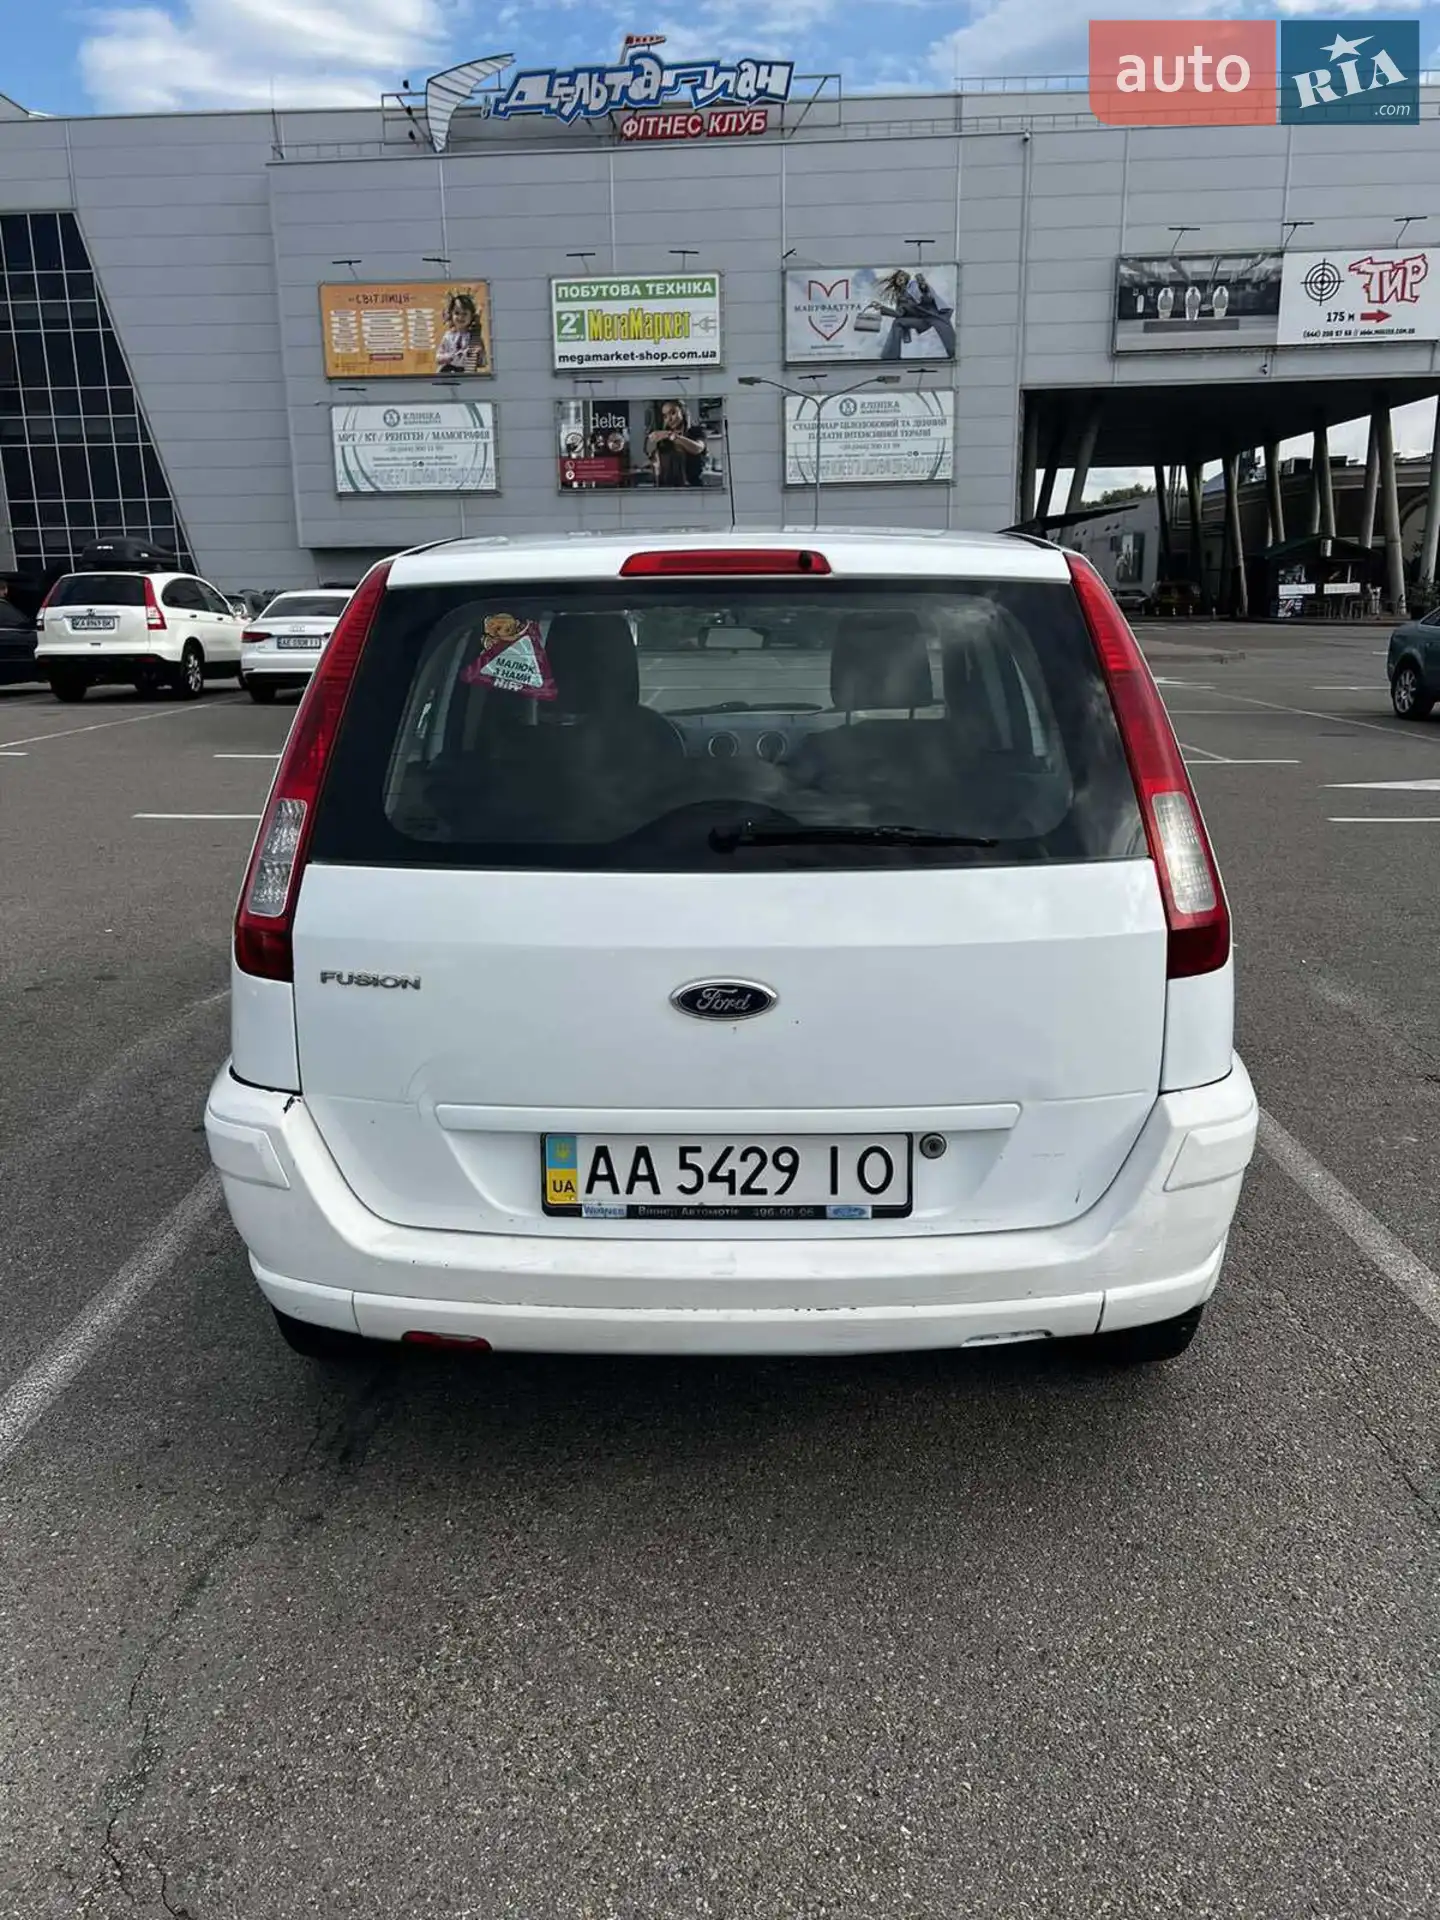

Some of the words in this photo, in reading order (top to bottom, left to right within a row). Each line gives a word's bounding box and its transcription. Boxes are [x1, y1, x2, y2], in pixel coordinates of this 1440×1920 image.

[622, 114, 702, 138] ФІТНЕС
[708, 110, 768, 133] КЛУБ
[1348, 253, 1429, 304] ТИР
[558, 283, 641, 299] ПОБУТОВА
[646, 281, 714, 298] ТЕХНІКА
[1326, 311, 1345, 322] 175
[588, 308, 691, 344] МегаМаркет
[558, 349, 717, 365] megamarket-shop.com.ua
[591, 412, 627, 429] delta
[496, 658, 535, 674] МАЛЮК
[501, 670, 531, 683] НАМИ
[320, 971, 422, 990] FUSION
[696, 987, 752, 1011] Ford
[552, 1179, 576, 1194] UA
[585, 1145, 662, 1195] AA
[676, 1144, 801, 1197] 5429
